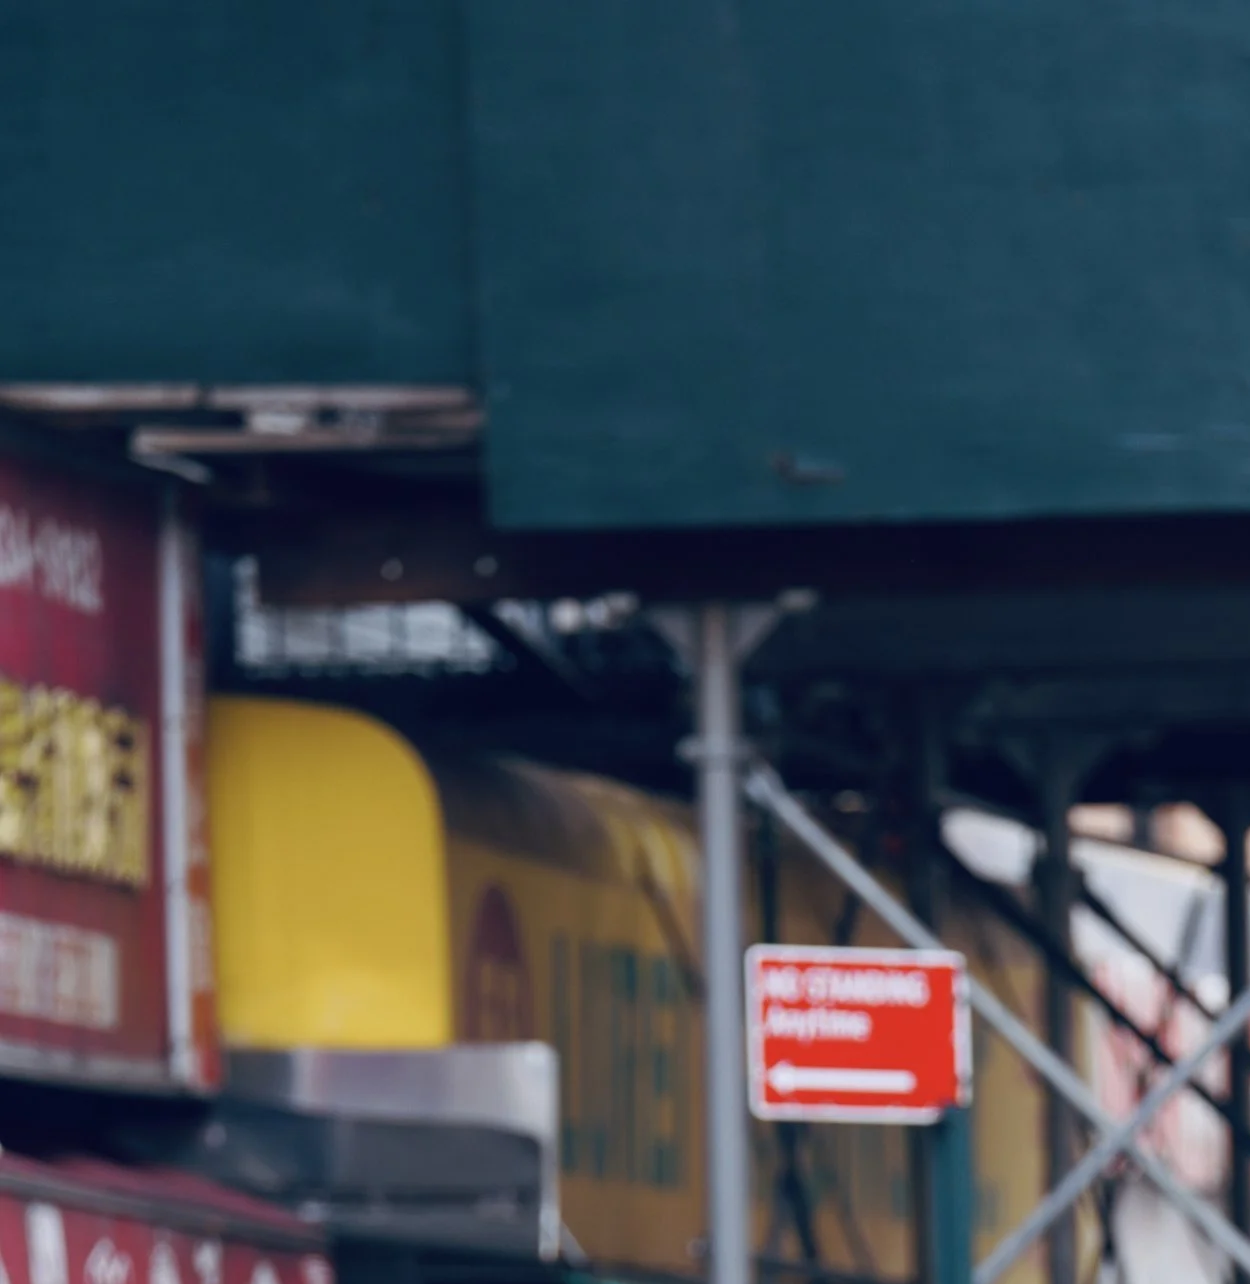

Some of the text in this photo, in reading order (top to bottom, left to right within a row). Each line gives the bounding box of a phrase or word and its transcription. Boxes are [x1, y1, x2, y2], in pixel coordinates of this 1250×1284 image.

[764, 965, 929, 1007] NO STANDING
[766, 1004, 872, 1047] Anytime
